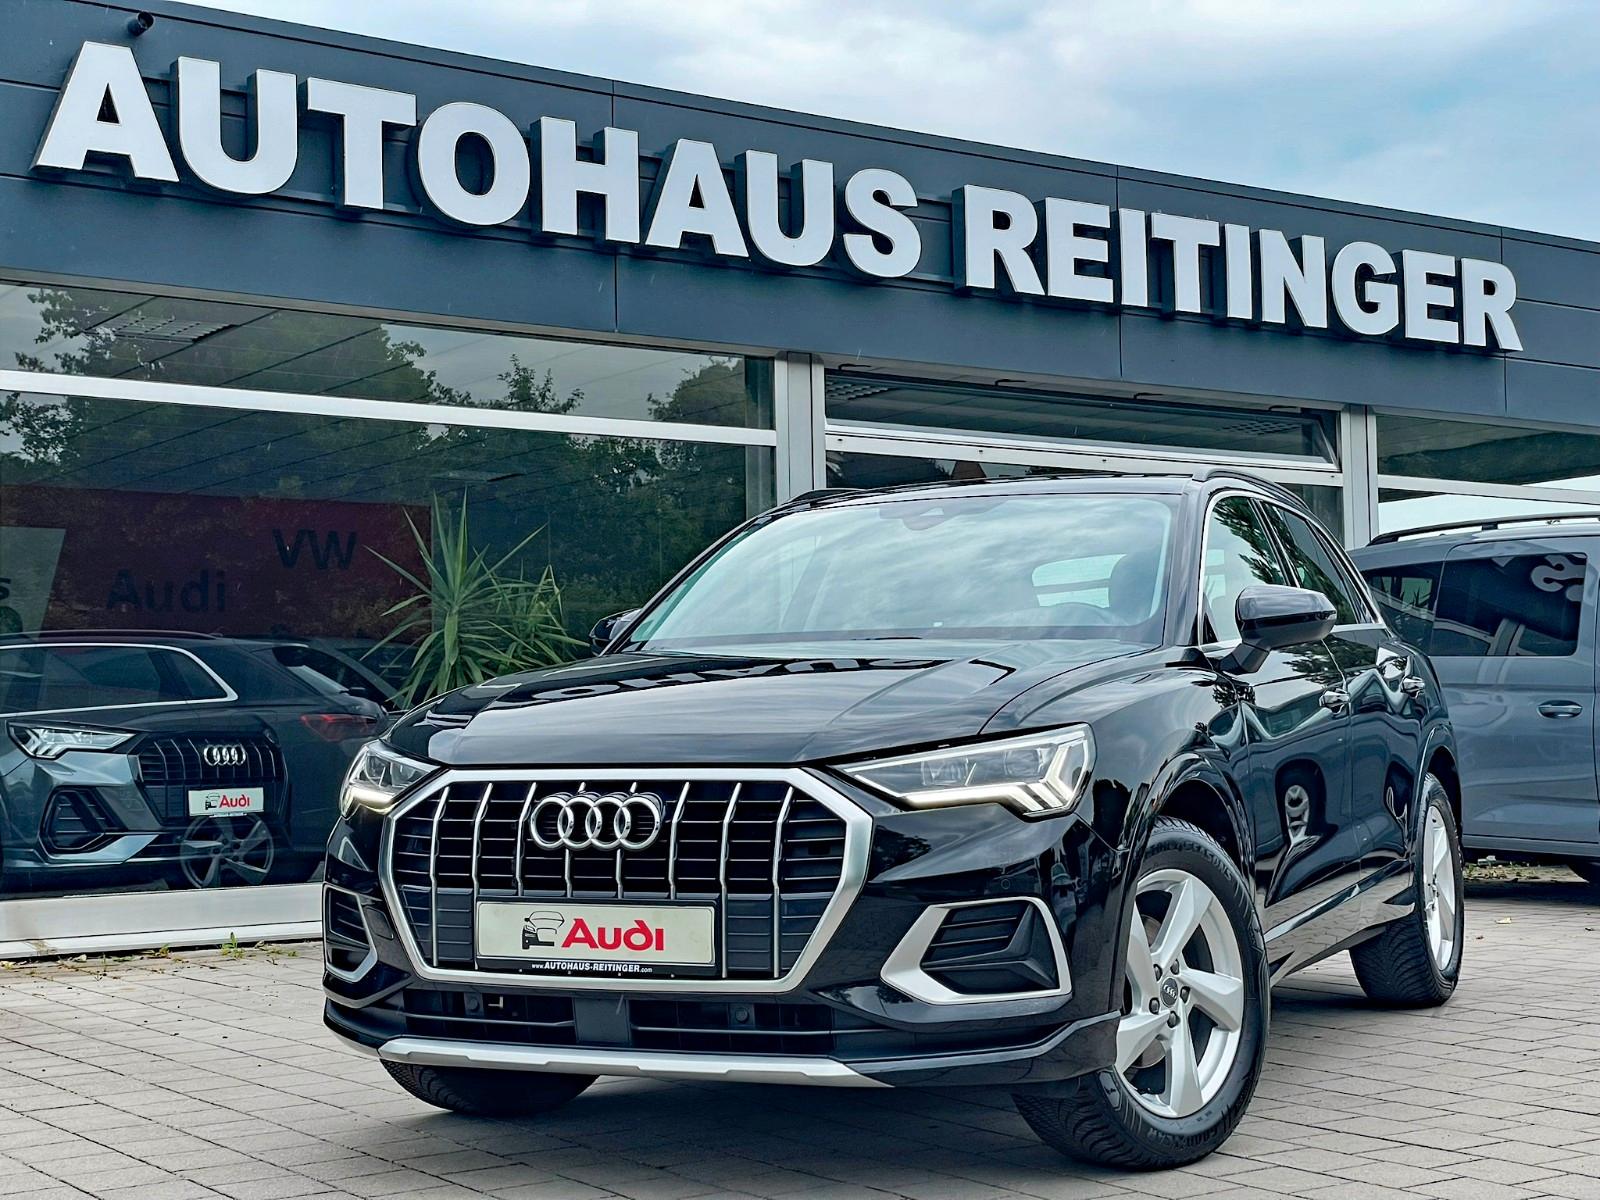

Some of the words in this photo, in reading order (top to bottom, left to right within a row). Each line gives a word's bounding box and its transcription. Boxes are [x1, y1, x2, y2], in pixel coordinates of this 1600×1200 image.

[32, 41, 922, 278] AUTOHAUS
[962, 184, 1524, 352] REITINGER
[272, 529, 358, 570] VW
[106, 569, 226, 613] Audi
[219, 794, 250, 809] Audi
[561, 918, 664, 951] Audi
